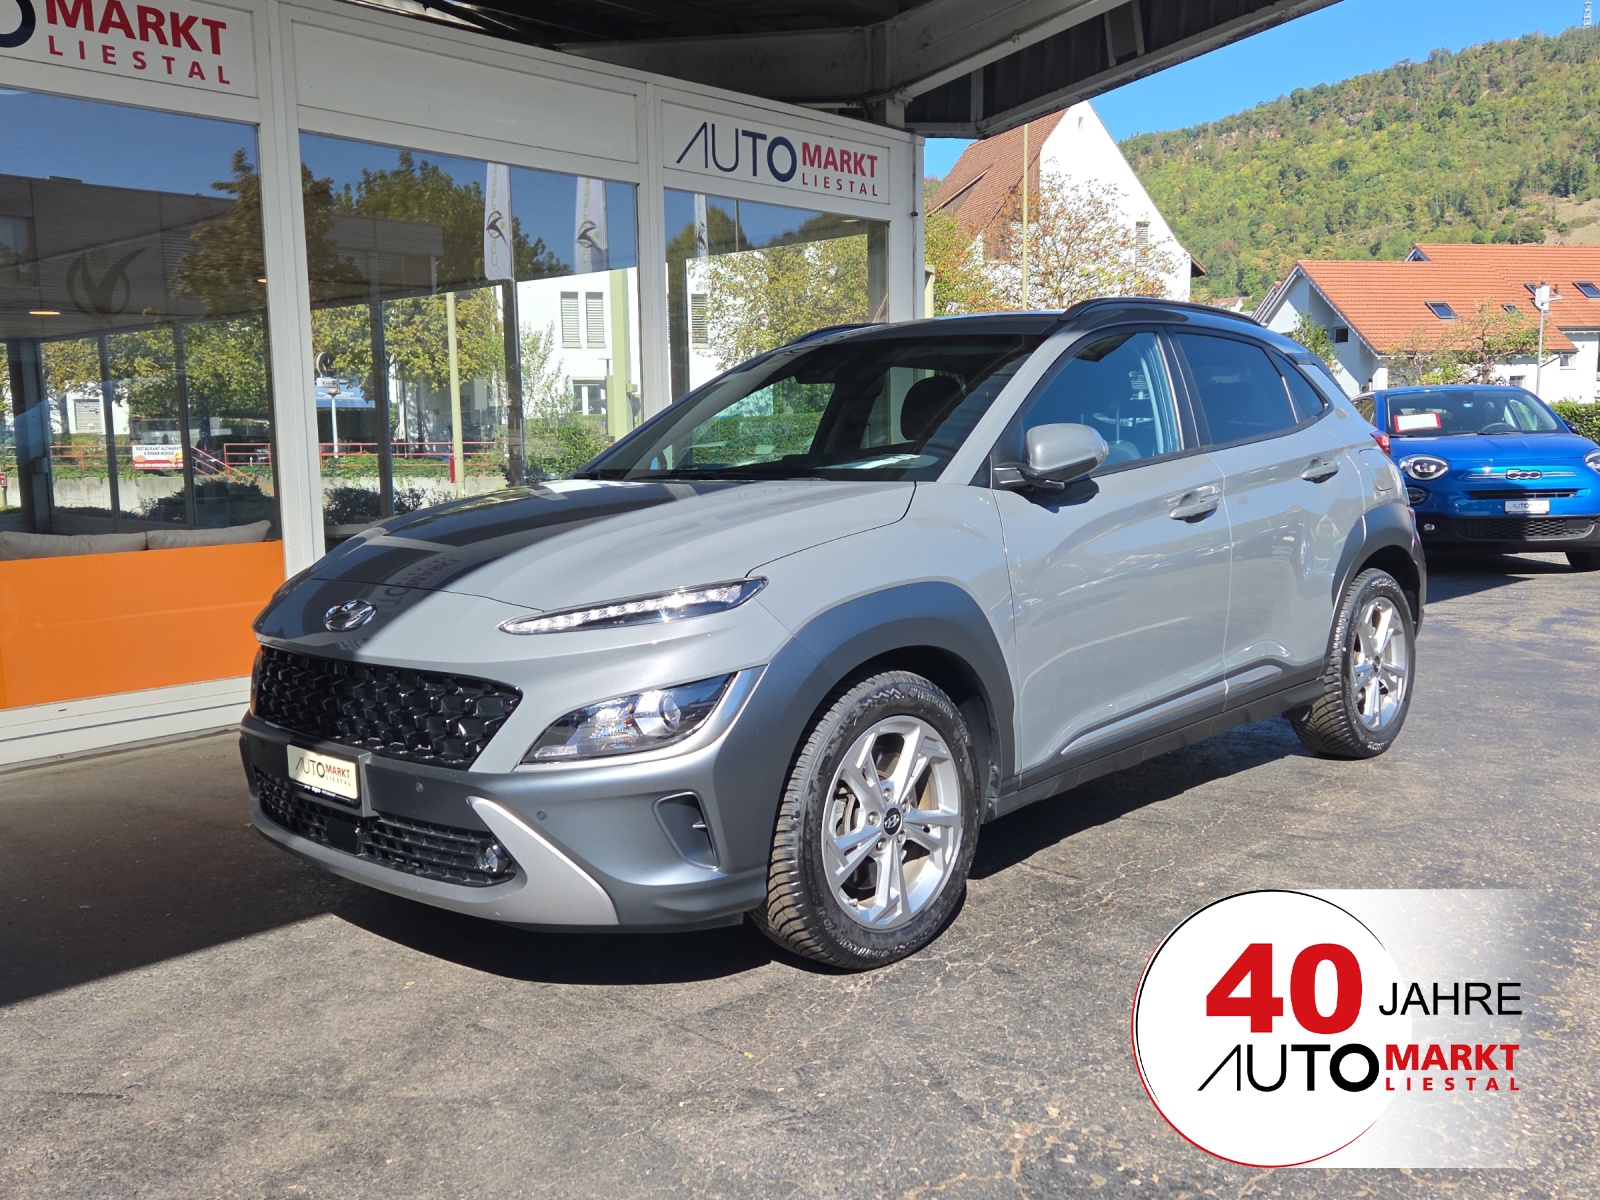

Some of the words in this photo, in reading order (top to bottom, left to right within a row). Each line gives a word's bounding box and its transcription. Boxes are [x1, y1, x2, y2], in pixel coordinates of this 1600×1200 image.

[45, 0, 227, 56] MARKT
[48, 35, 231, 85] LIESTAL
[675, 121, 798, 183] AUTO
[801, 141, 878, 178] MARKT
[801, 172, 878, 197] LIESTAL
[1506, 469, 1542, 480] 500
[295, 757, 325, 778] AUTO
[325, 764, 350, 779] MARKT
[325, 775, 351, 786] LIESTAL
